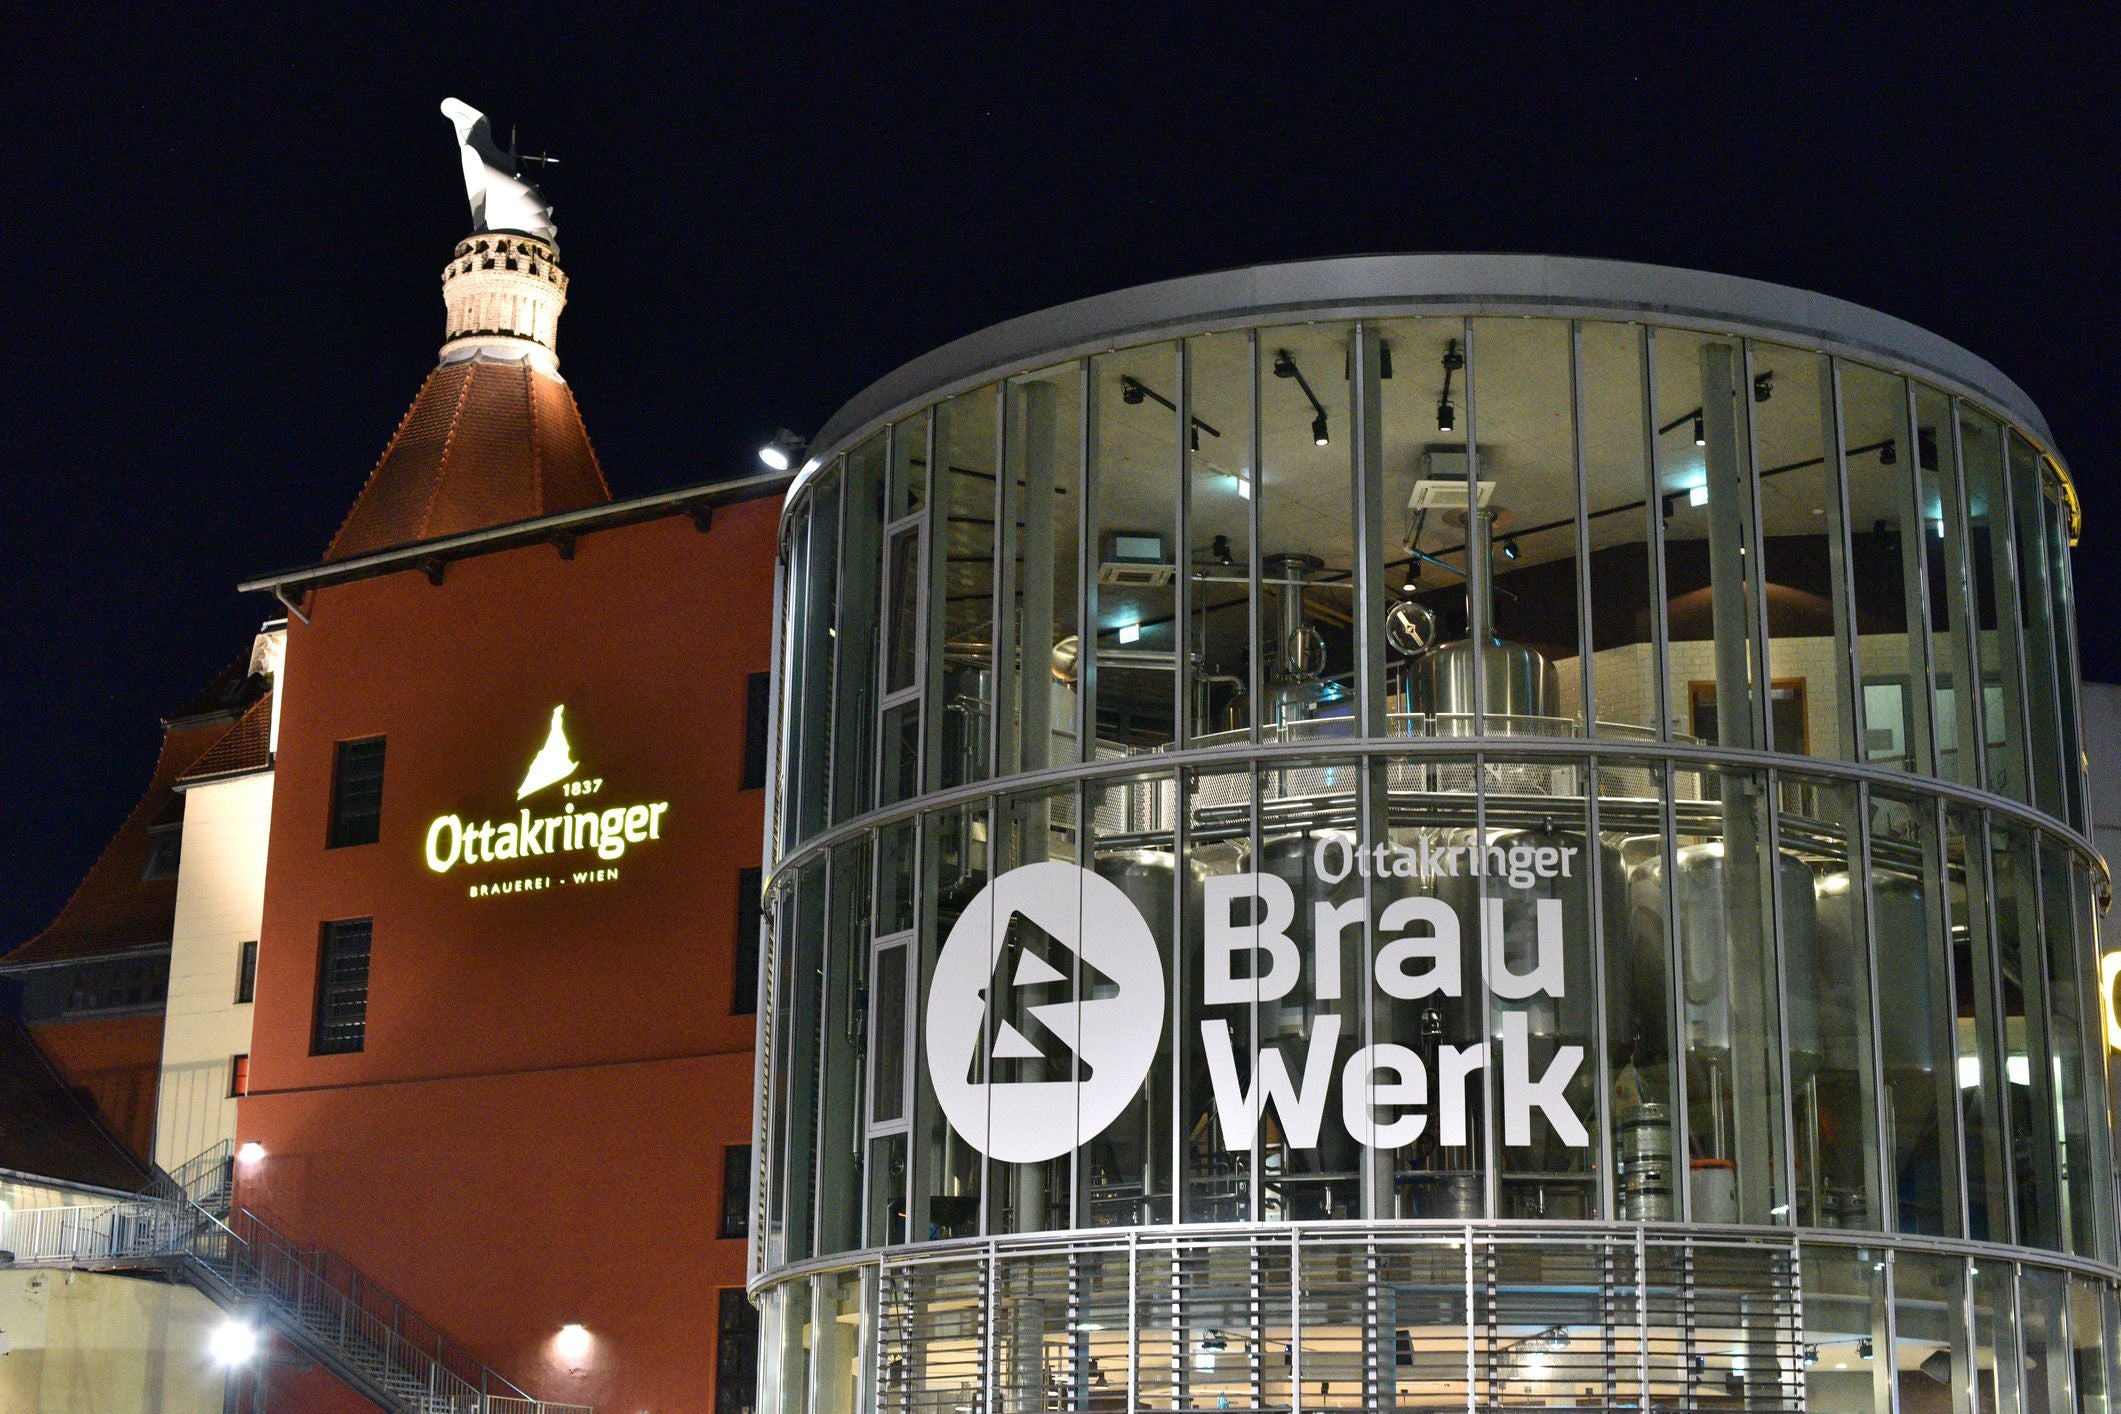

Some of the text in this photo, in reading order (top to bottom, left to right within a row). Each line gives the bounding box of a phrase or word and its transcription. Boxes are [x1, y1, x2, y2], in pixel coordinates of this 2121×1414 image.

[562, 778, 603, 797] 1837
[425, 801, 668, 873] Ottakringer
[1313, 835, 1578, 889] Ottakringer
[469, 868, 619, 898] BRAUEREI WIEN
[1203, 872, 1565, 1005] Brau
[1200, 1011, 1589, 1152] Werk
